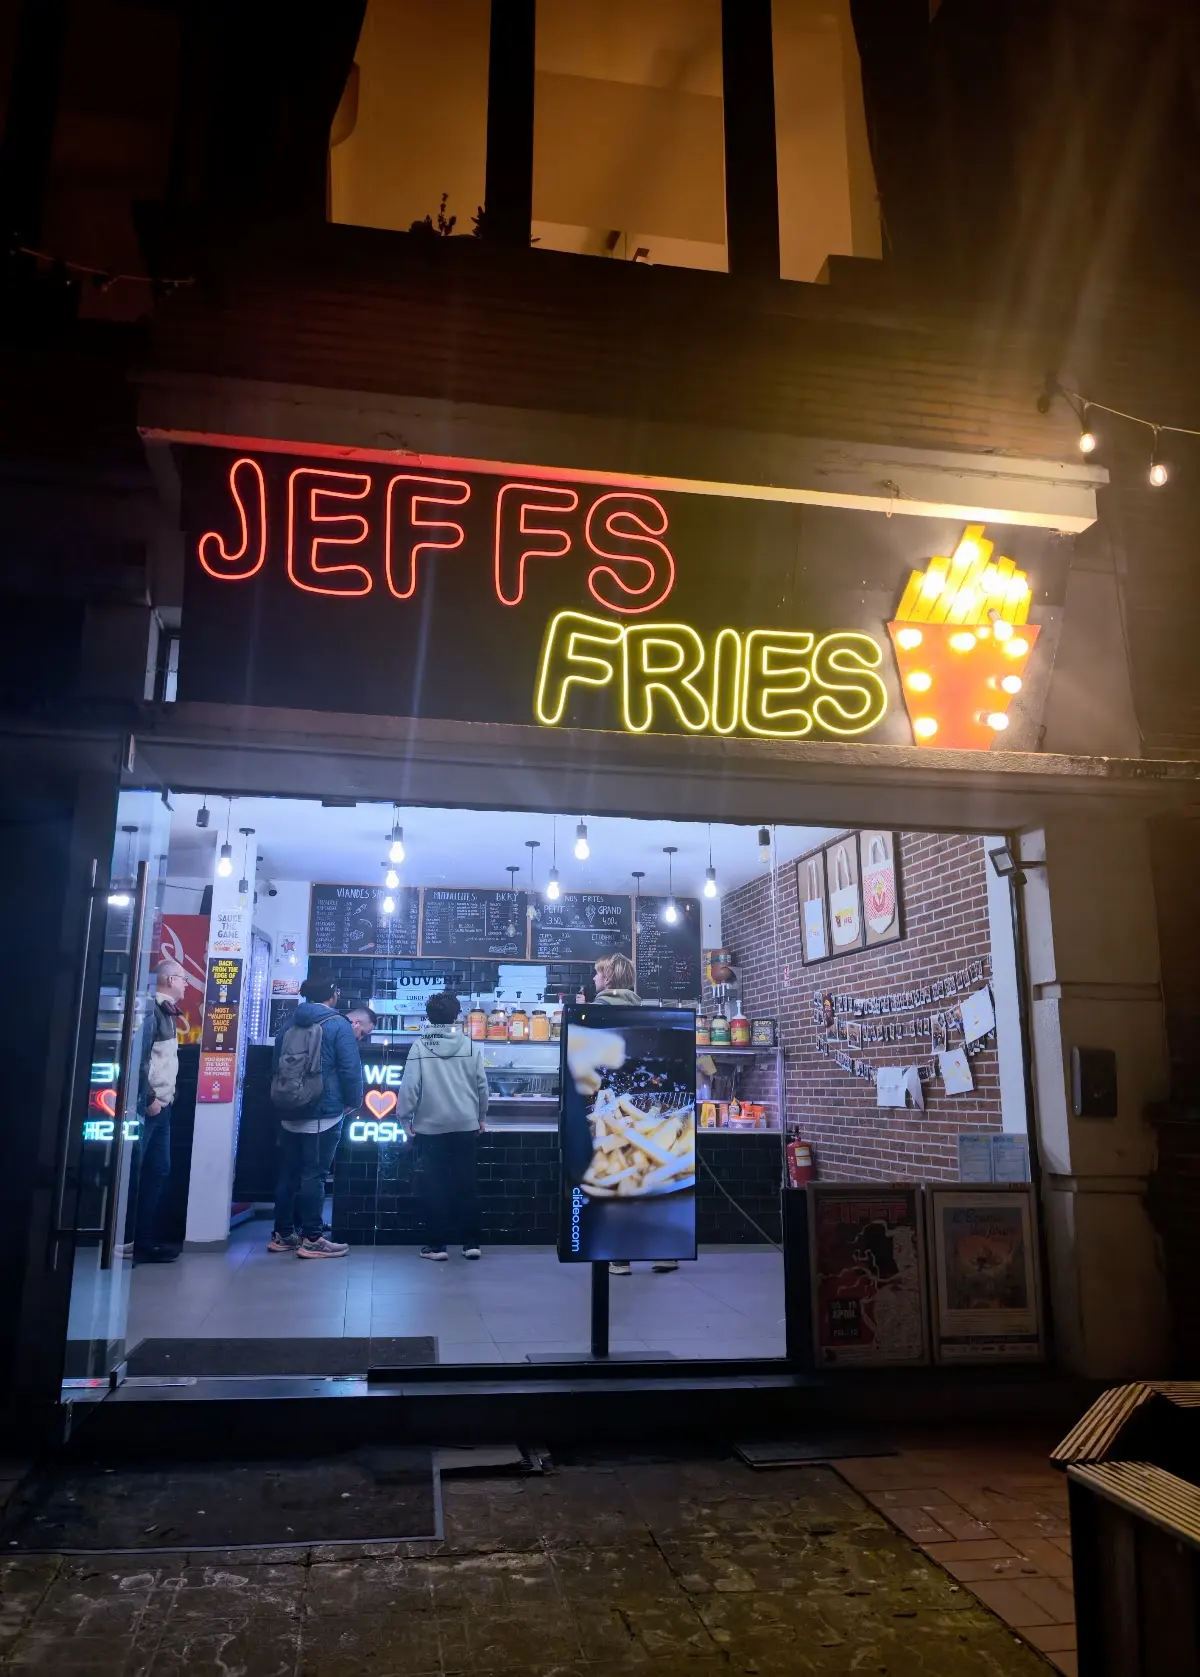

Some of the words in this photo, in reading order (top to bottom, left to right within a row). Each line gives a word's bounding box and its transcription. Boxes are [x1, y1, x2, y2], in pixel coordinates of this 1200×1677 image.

[198, 458, 676, 615] JEFFS
[534, 609, 889, 738] FRIES
[217, 914, 243, 923] SAUCE
[597, 905, 622, 915] GRAND
[217, 931, 239, 939] GAME
[222, 922, 237, 931] THE
[363, 1064, 404, 1086] WE
[349, 1121, 408, 1143] CASH
[571, 1187, 583, 1252] clideo.com
